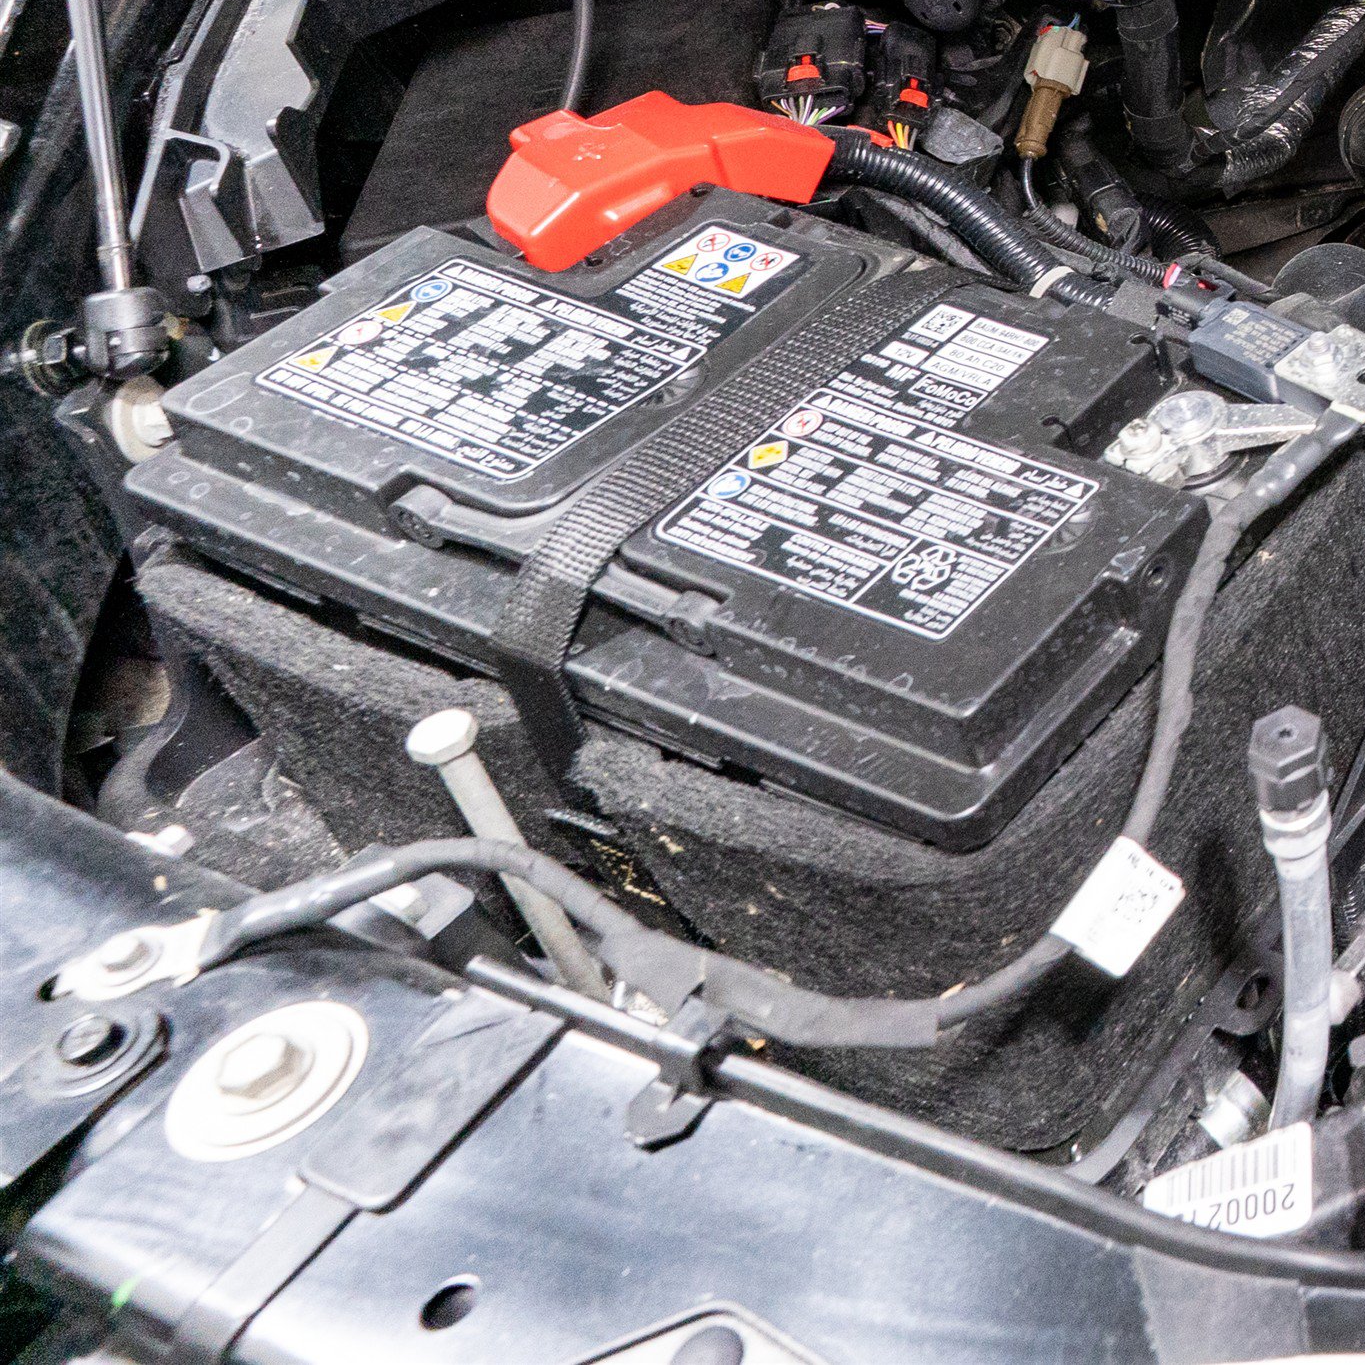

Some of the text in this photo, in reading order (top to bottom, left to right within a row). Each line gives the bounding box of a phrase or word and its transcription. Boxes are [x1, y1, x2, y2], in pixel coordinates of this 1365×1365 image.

[892, 348, 916, 358] 12V
[883, 364, 921, 382] MF
[930, 362, 992, 385] AGM/VRLA
[981, 361, 1004, 370] C20
[914, 379, 980, 406] FoMoCo
[825, 399, 916, 436] DANGER/POISON
[929, 436, 1021, 473] PELIGRO/VENENO
